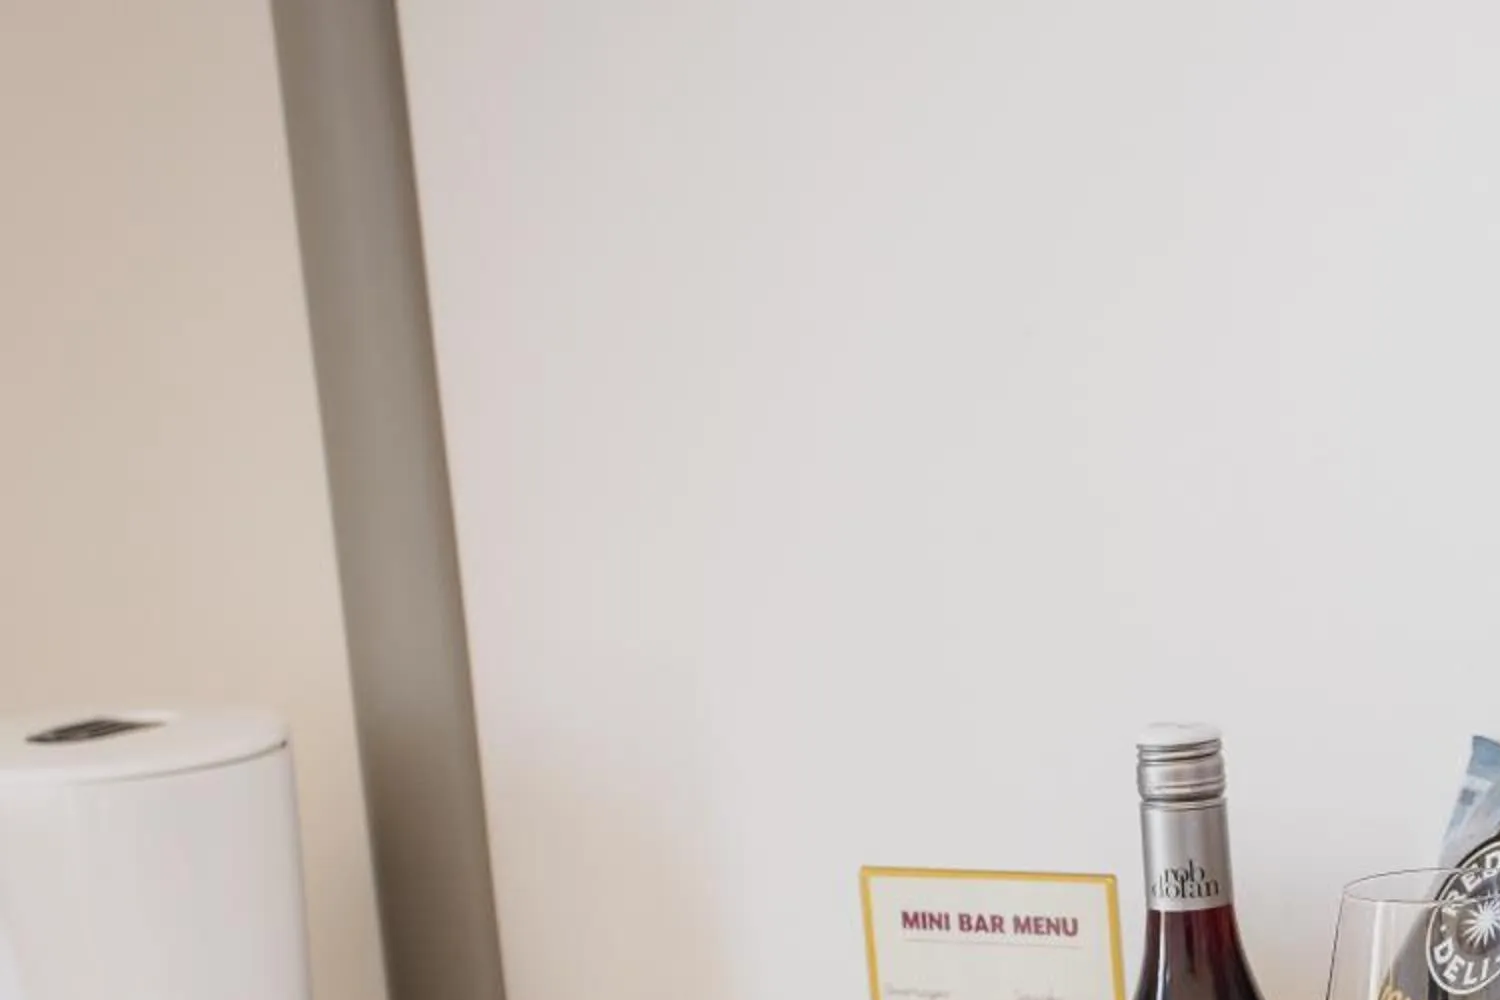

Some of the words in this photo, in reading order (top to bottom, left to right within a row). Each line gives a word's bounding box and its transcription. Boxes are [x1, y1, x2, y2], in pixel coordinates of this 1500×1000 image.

[901, 910, 951, 932] MINI
[958, 913, 1006, 934] BAR
[1013, 915, 1079, 937] MENU
[1433, 937, 1490, 985] DELI
